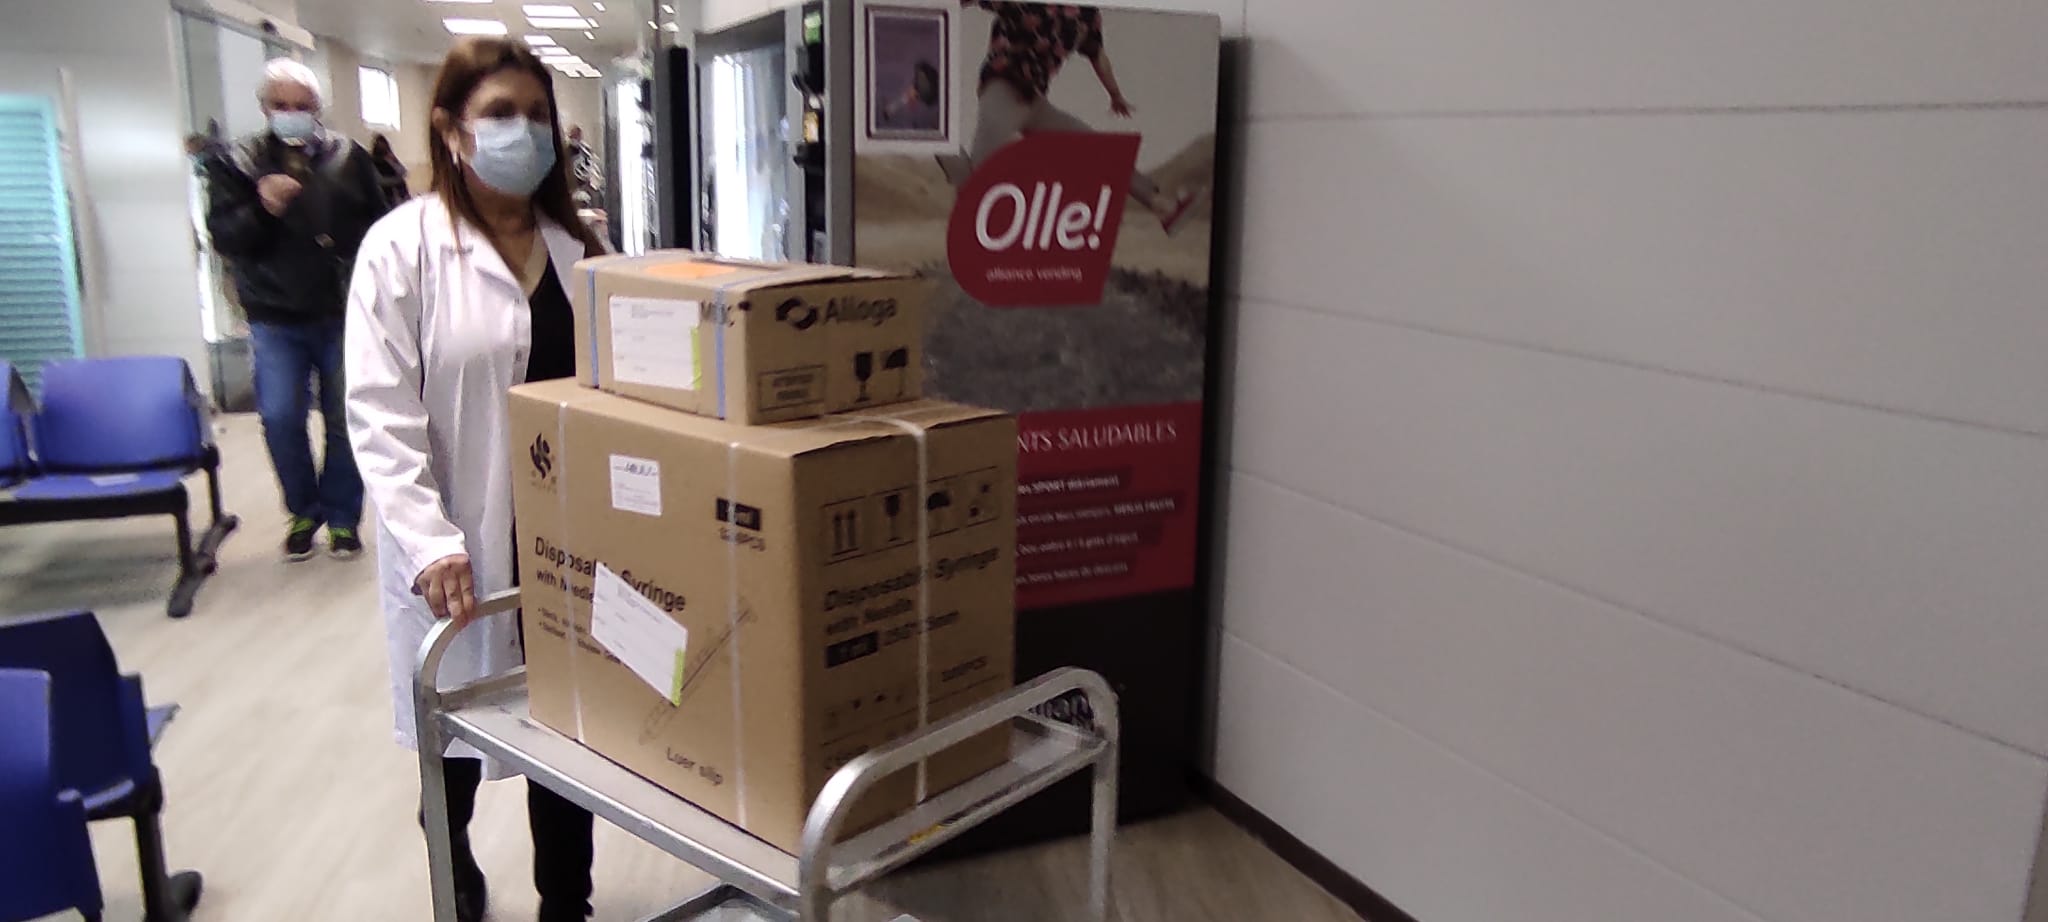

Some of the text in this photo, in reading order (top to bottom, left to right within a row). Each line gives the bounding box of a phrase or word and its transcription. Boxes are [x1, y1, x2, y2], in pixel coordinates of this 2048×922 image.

[975, 181, 1112, 251] Olle!
[823, 296, 897, 328] Alloga
[1058, 421, 1177, 450] SALUDABLES
[535, 536, 686, 612] Disposa Syringe
[536, 569, 556, 586] with
[667, 747, 724, 787] Luer slip
